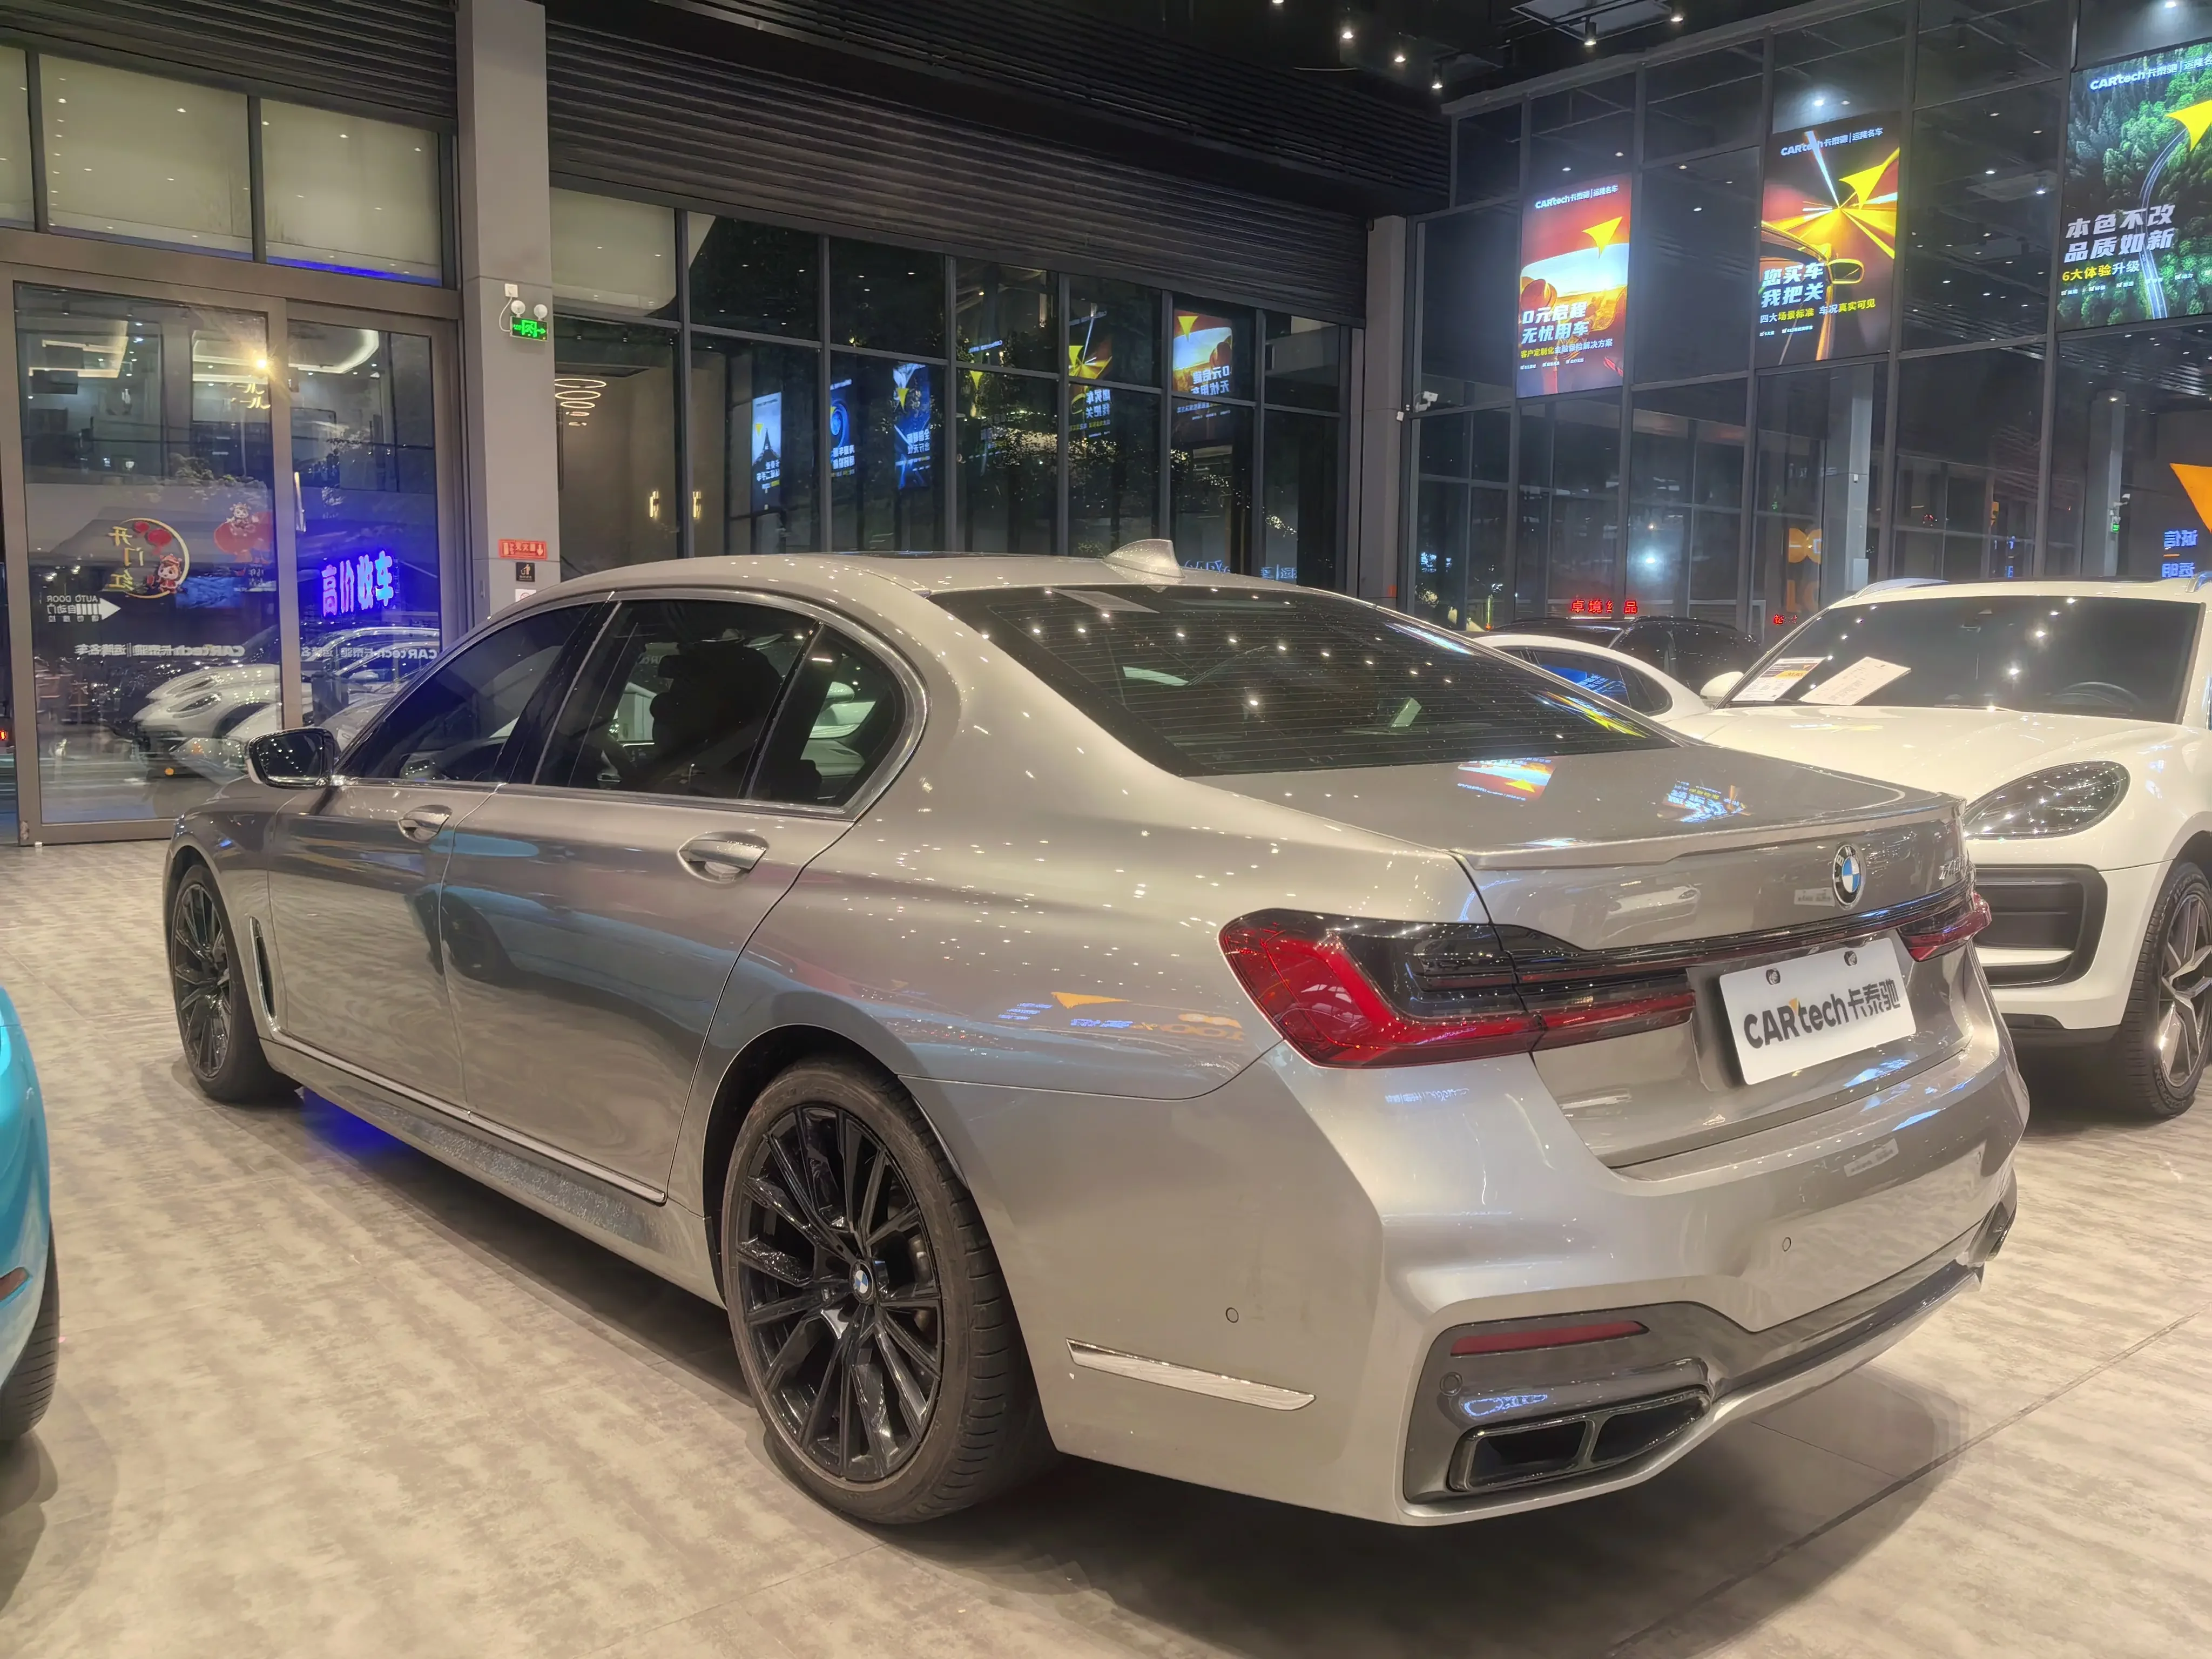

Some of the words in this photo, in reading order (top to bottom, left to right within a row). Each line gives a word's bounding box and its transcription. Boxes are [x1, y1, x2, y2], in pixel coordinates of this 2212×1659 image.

[2065, 203, 2175, 238] 本色不改
[2064, 227, 2175, 263] 品质如新
[1762, 261, 1825, 287] 您买车
[2062, 260, 2140, 282] 6大体验升级
[1761, 282, 1824, 308] 我把关
[1522, 301, 1588, 324] 0元启程
[1760, 307, 1815, 324] 四大场景标准
[1819, 298, 1876, 315] 车况真实可见
[1521, 321, 1590, 344] 无忧用车
[321, 550, 394, 617] 高价收车
